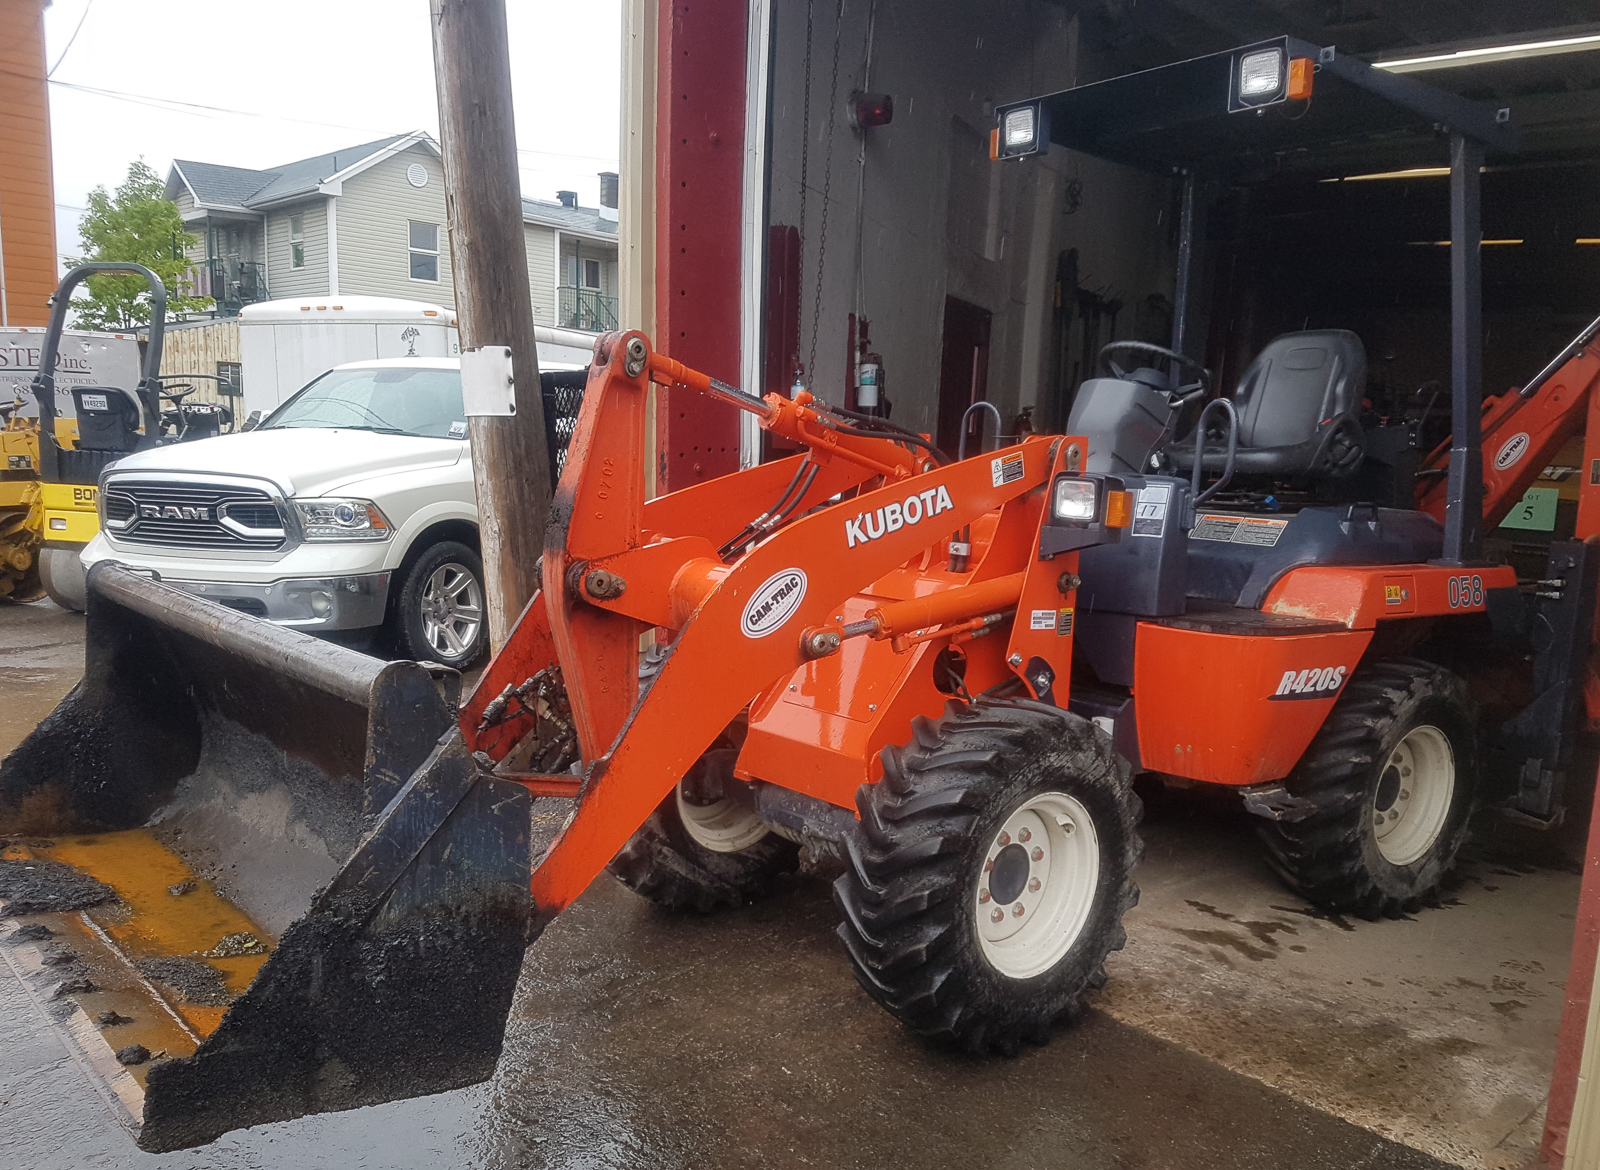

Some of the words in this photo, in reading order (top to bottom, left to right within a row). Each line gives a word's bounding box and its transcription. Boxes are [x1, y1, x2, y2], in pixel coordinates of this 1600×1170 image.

[64, 354, 92, 369] inc.
[1499, 437, 1524, 464] CAM-TRAC
[140, 505, 209, 520] RAM
[845, 484, 954, 549] KUBOTA
[1523, 506, 1534, 520] 5
[749, 577, 798, 626] CAM-TRAC
[1448, 575, 1483, 608] 058
[1275, 665, 1346, 695] R420S
